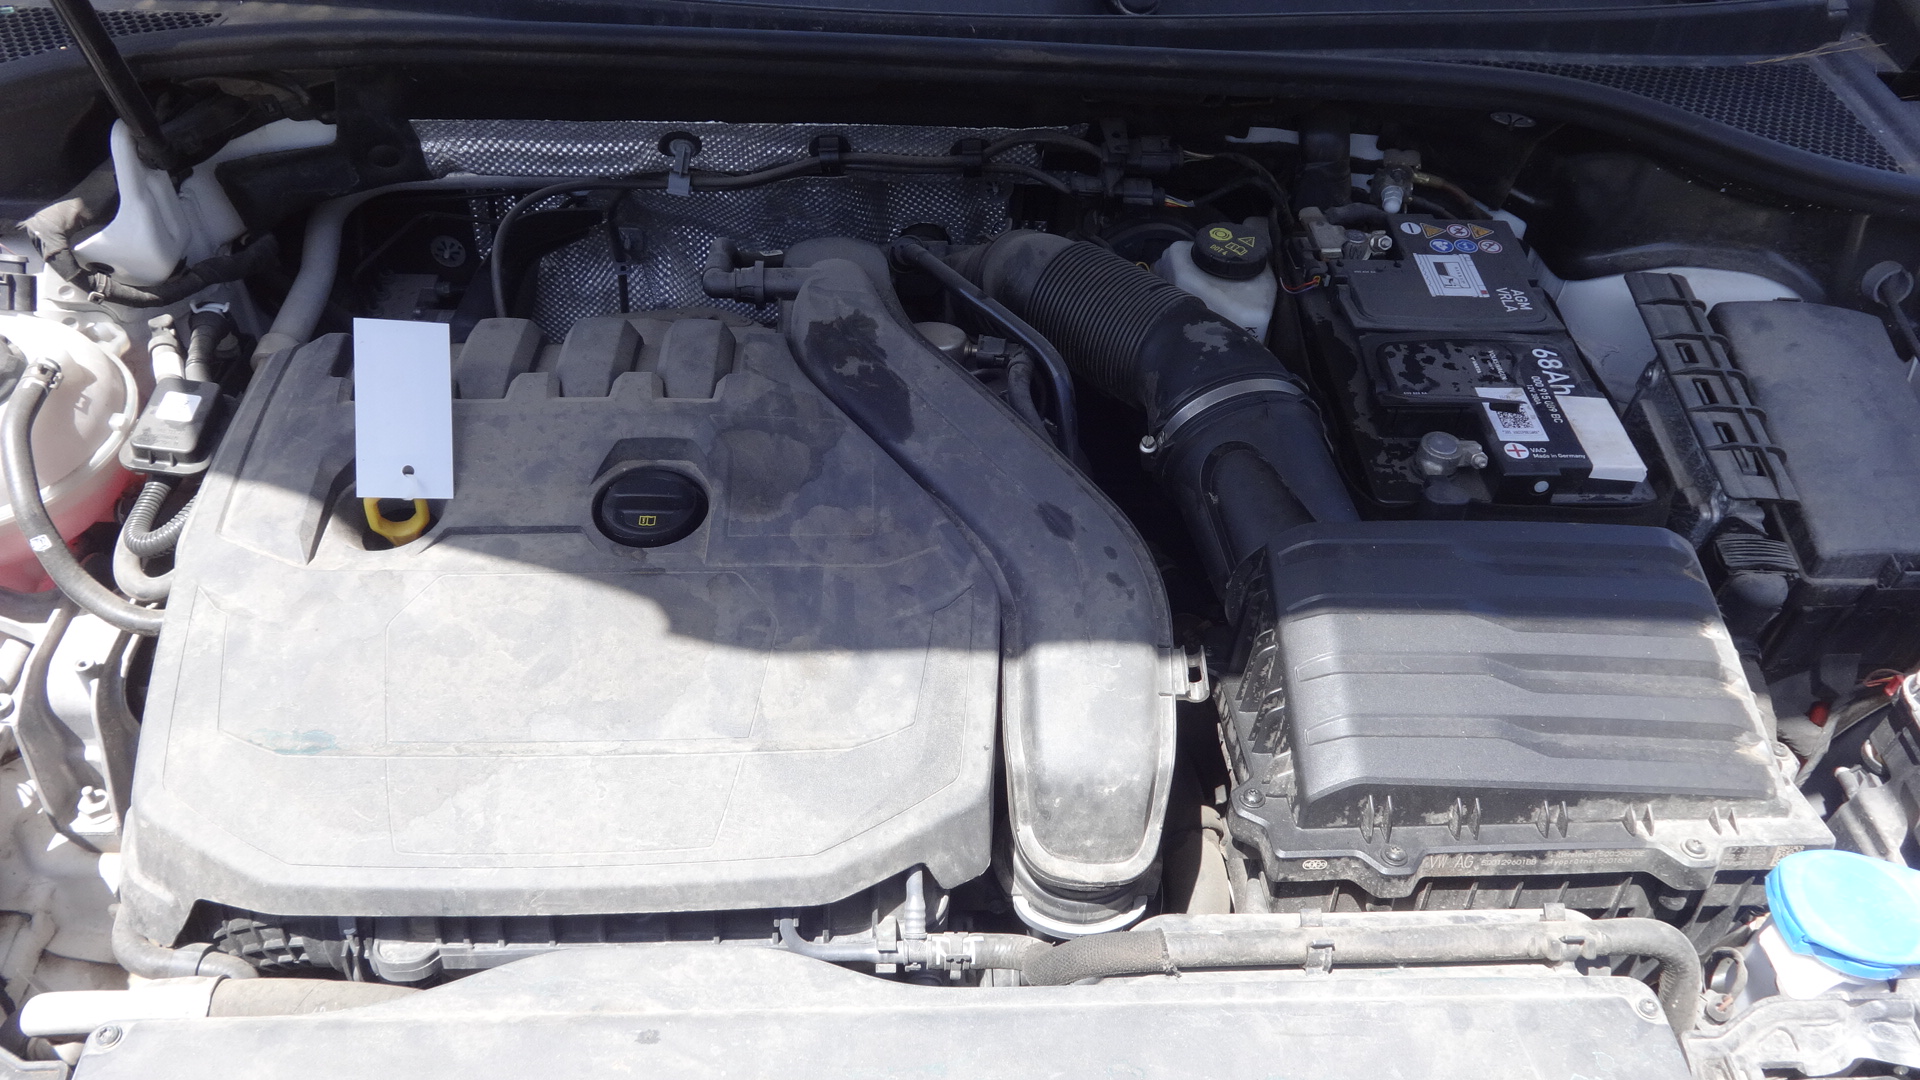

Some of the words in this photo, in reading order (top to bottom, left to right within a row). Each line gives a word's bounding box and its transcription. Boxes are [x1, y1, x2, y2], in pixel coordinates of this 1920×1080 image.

[1210, 244, 1224, 252] DOT
[1496, 287, 1518, 312] VRLA
[1510, 289, 1533, 310] AGM
[1531, 348, 1575, 395] 68Ah
[1531, 375, 1545, 388] 000
[1538, 388, 1551, 400] 915
[1550, 413, 1564, 423] BC
[1429, 855, 1448, 869] VW
[1454, 855, 1475, 869] AG
